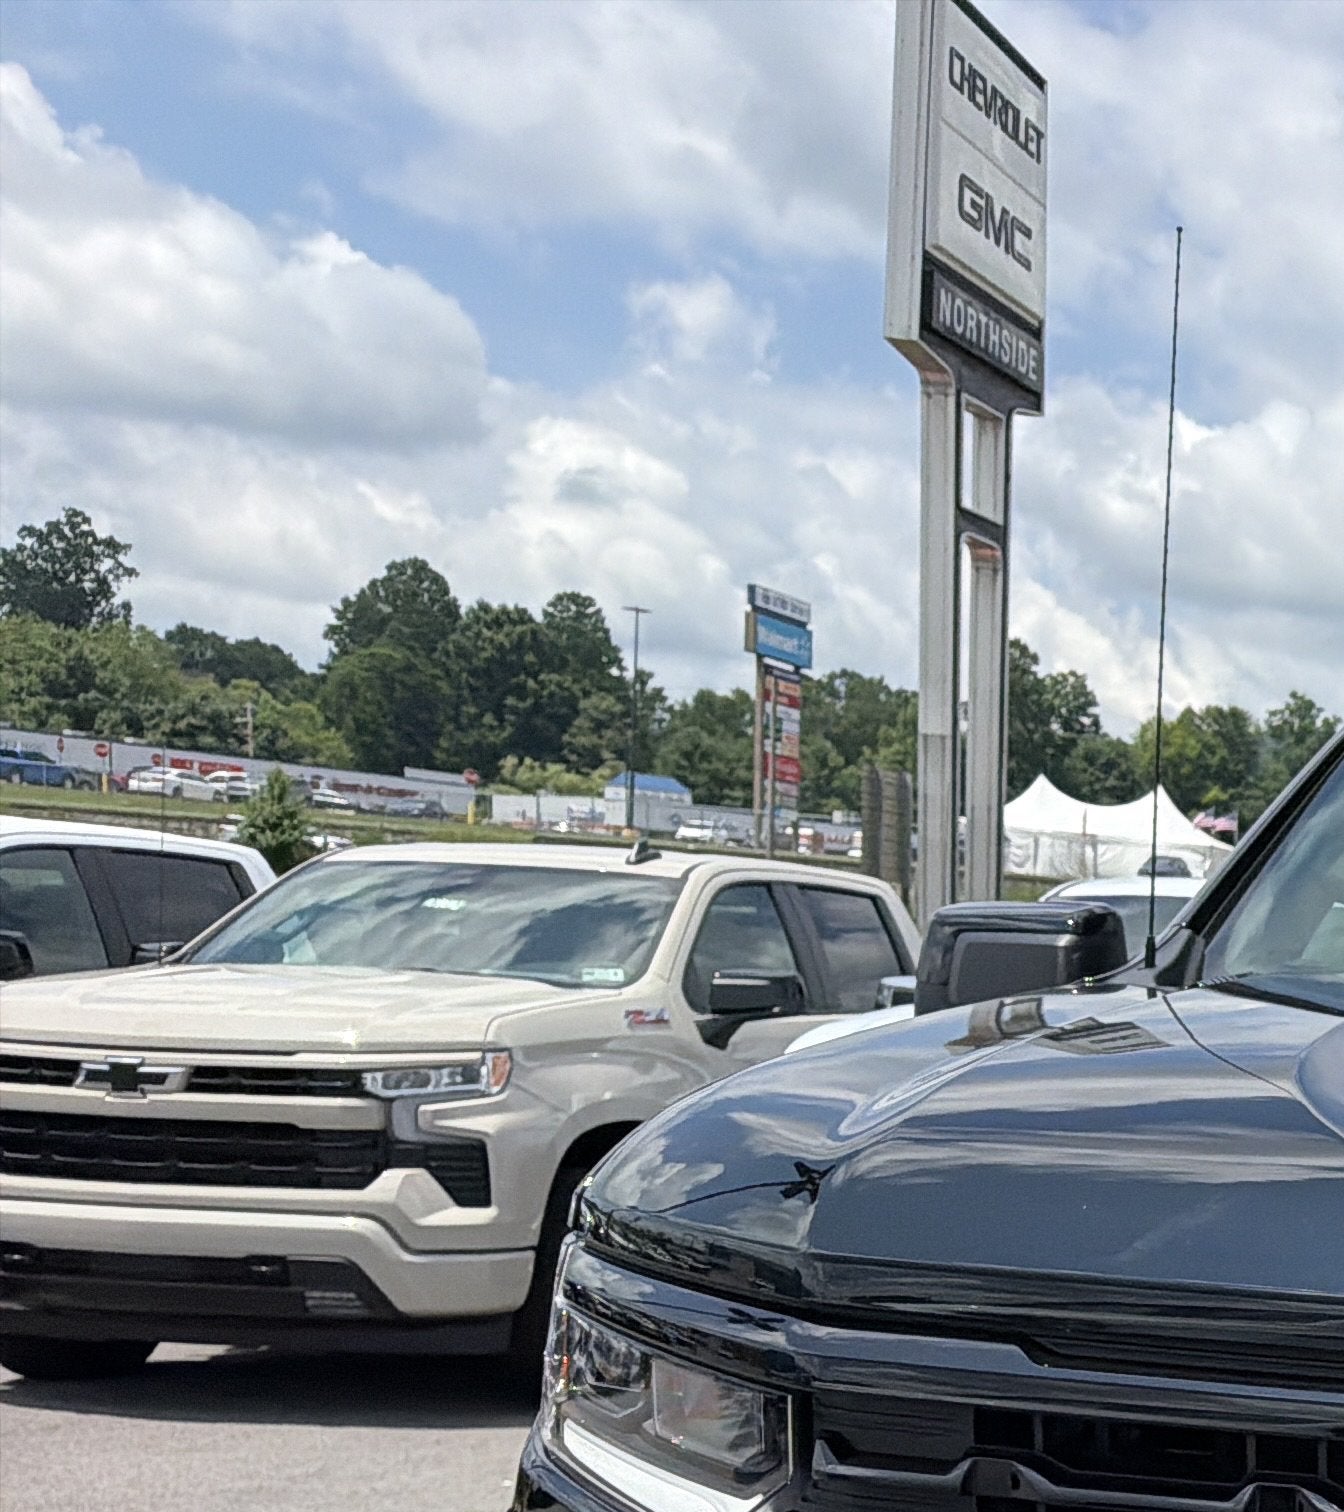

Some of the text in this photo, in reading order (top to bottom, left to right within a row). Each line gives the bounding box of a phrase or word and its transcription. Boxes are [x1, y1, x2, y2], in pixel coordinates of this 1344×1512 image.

[949, 46, 1045, 164] CHEVROLET
[958, 173, 1032, 272] GMC
[939, 288, 1038, 381] NORTHSIDE
